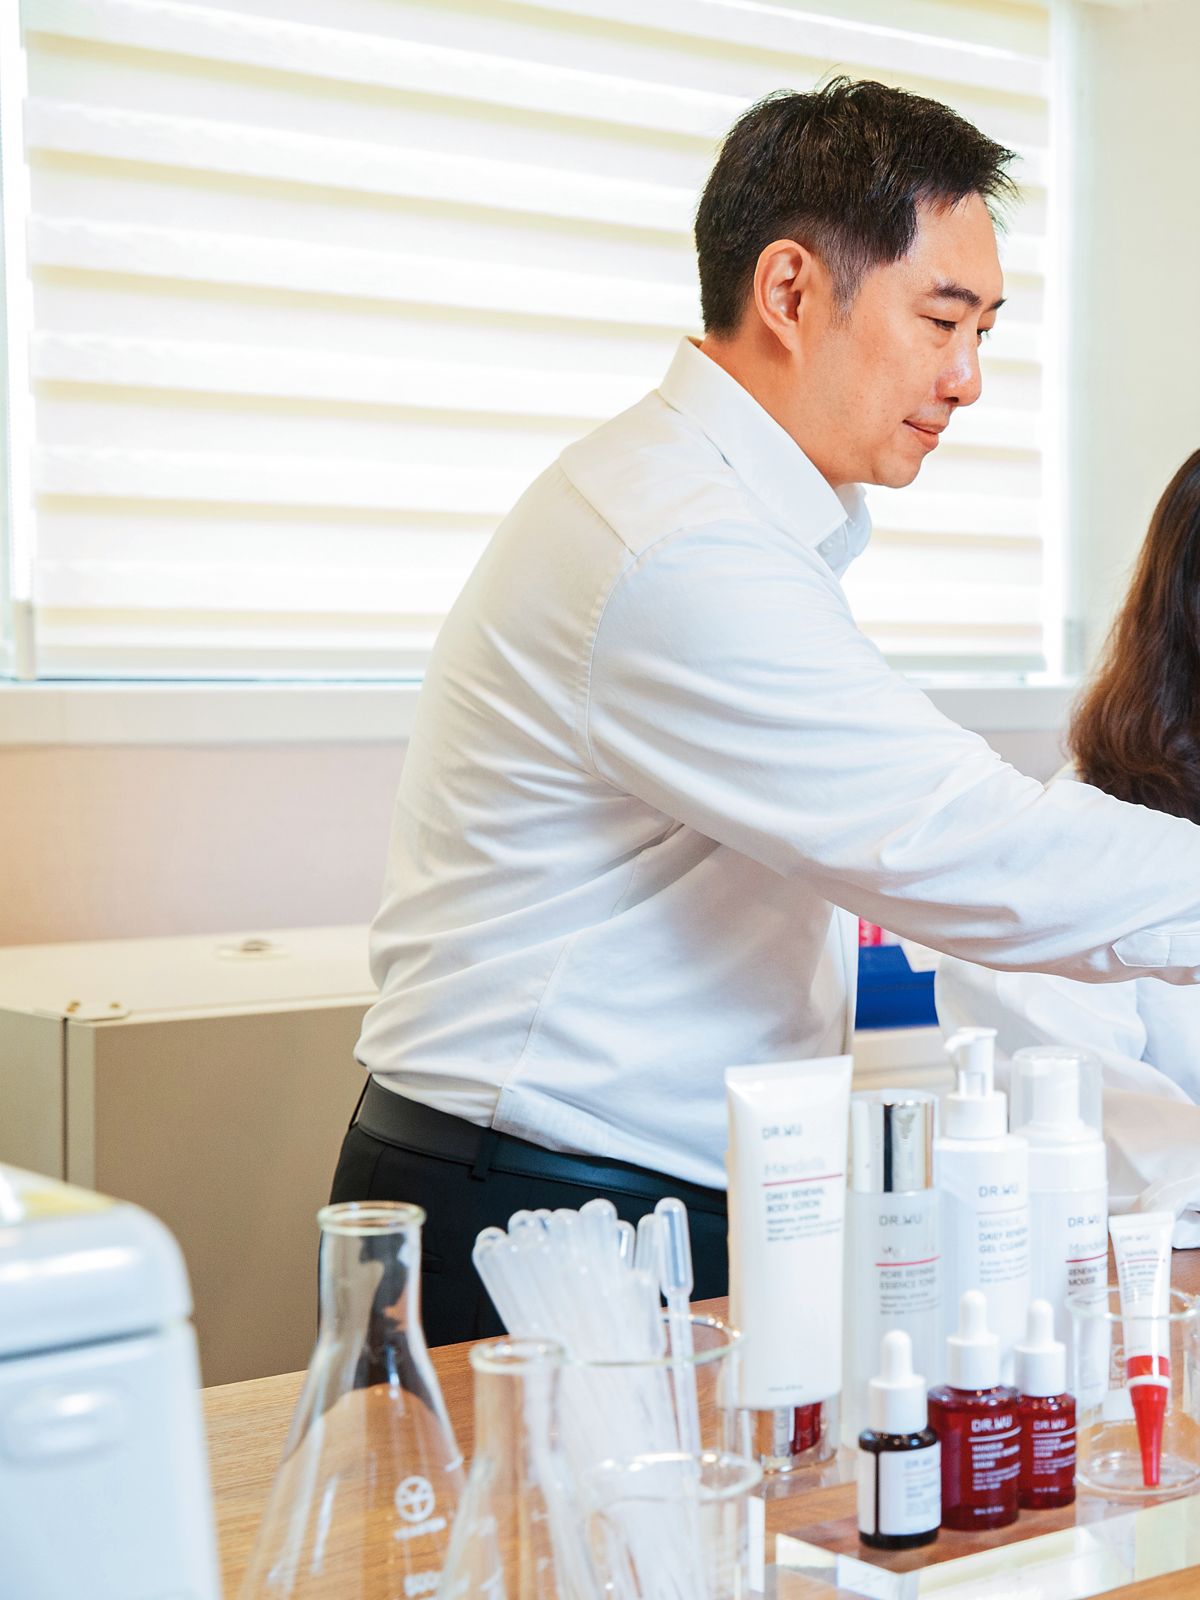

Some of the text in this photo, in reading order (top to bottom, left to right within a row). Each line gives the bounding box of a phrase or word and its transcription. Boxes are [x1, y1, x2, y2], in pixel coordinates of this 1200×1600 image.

[762, 1124, 803, 1139] DR.WU
[978, 1184, 1019, 1198] DR.WU
[879, 1213, 922, 1226] DR.WU
[1067, 1214, 1100, 1227] DR.WU
[971, 1415, 1013, 1433] DR.WU
[1033, 1419, 1067, 1432] DR.WU
